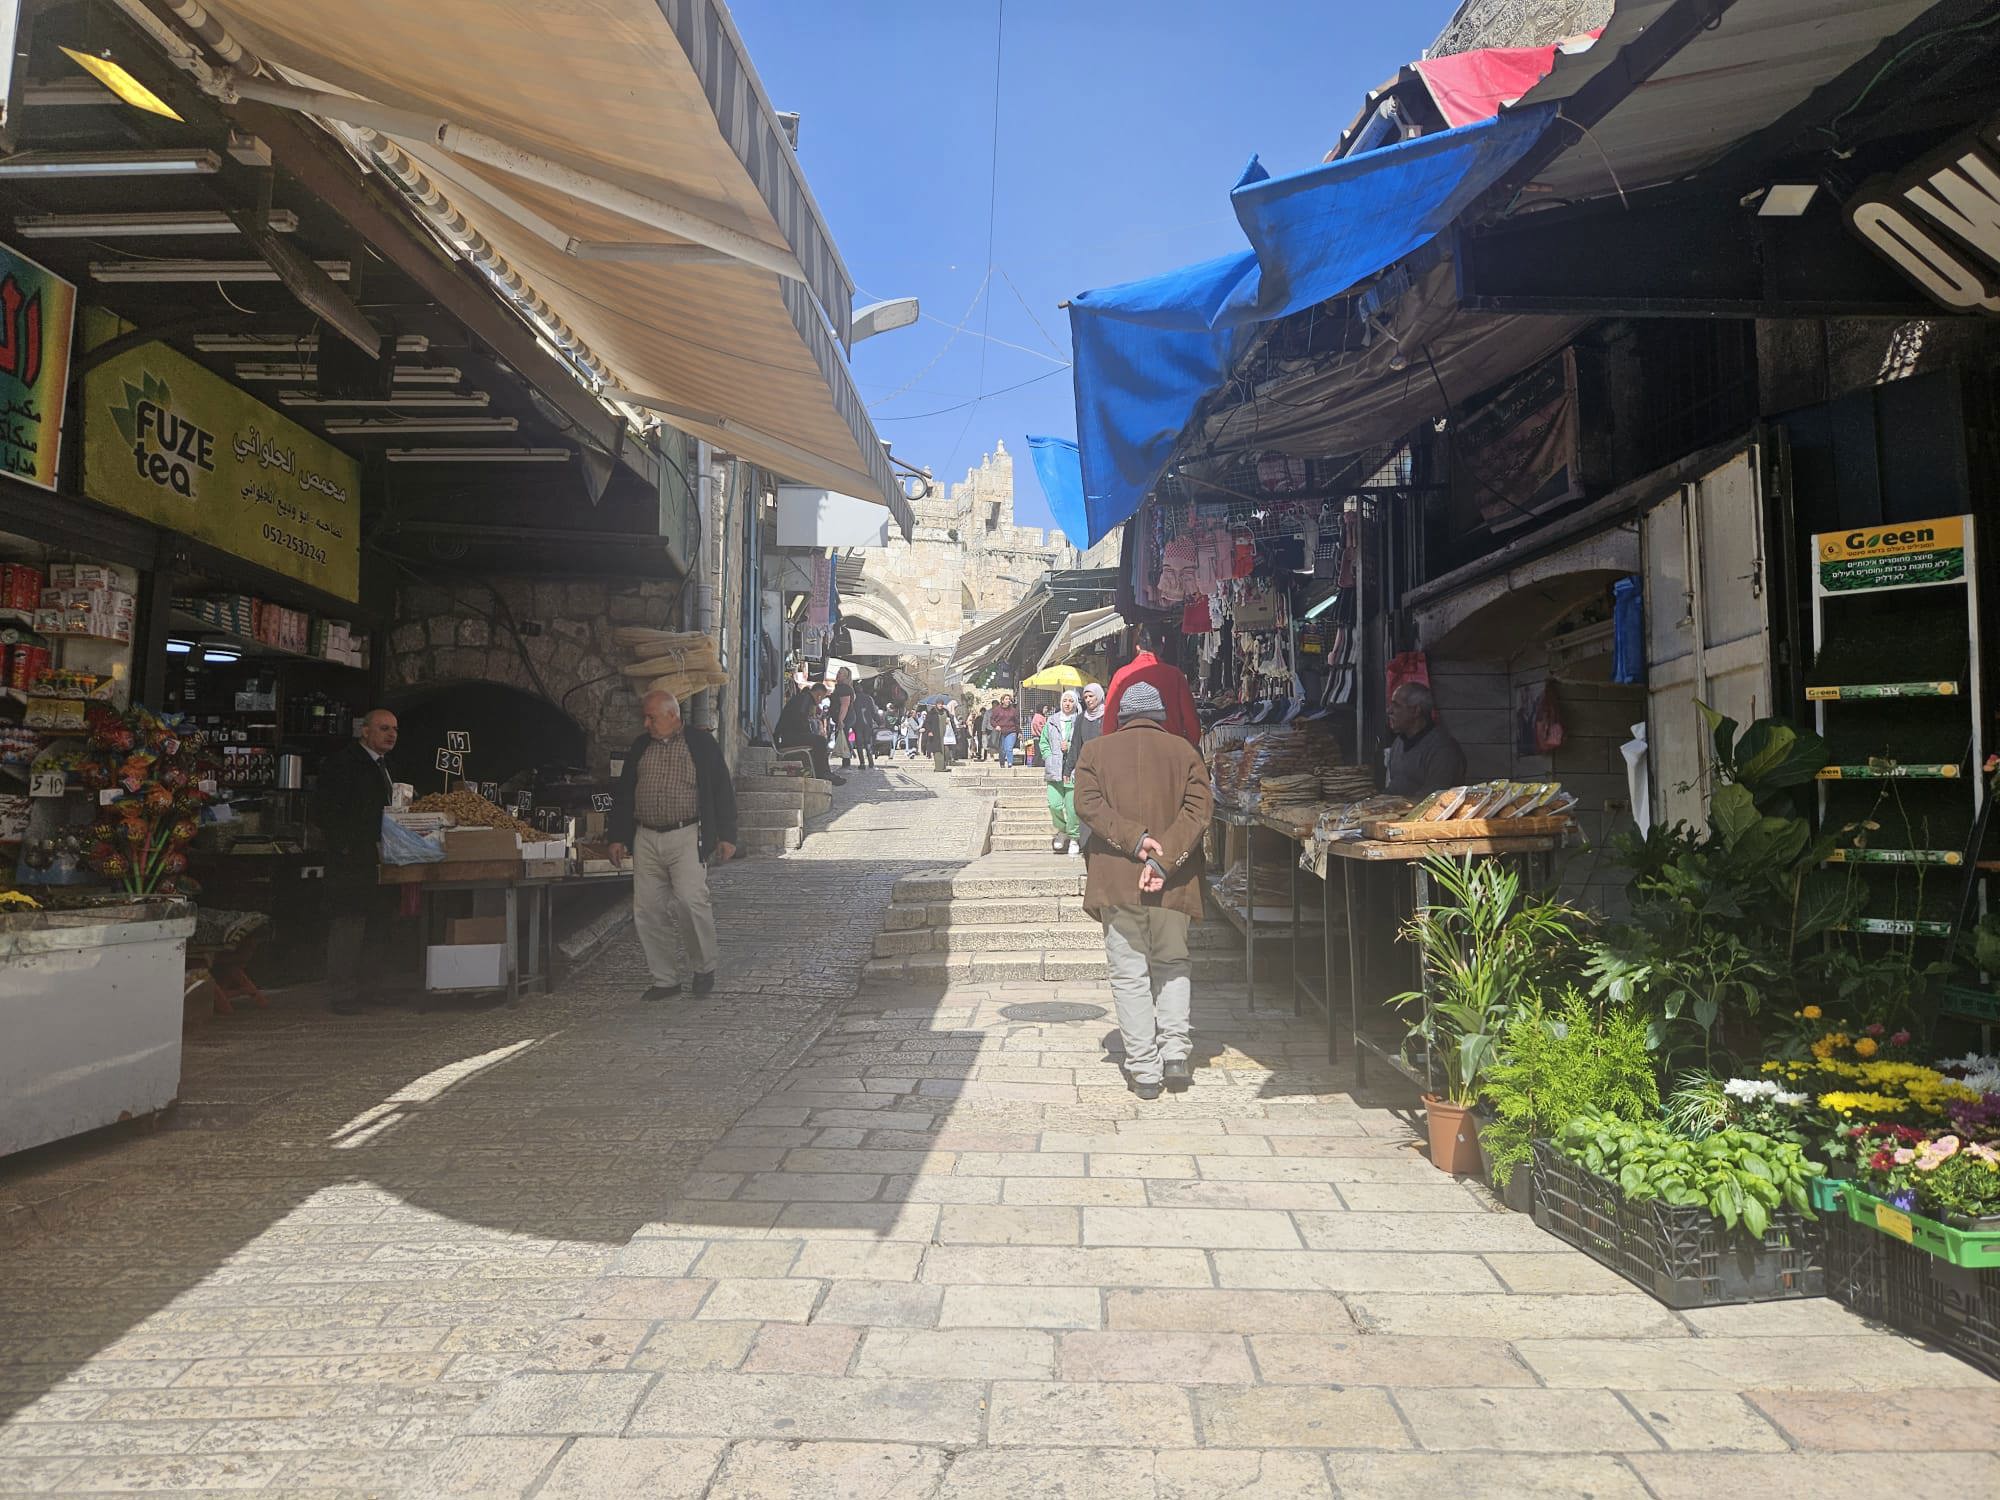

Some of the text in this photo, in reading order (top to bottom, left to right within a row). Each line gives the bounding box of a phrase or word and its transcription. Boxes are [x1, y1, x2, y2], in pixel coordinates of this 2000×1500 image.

[137, 401, 214, 472] FUZE
[133, 442, 191, 497] tea
[232, 426, 346, 504] محمص الحلواني
[263, 523, 327, 565] 052-2532242
[1879, 556, 1911, 565] מחומרים
[1912, 553, 1933, 562] מיוצר
[1934, 560, 1949, 569] ללא
[1909, 562, 1933, 571] מתכות
[1893, 573, 1904, 581] לא
[451, 734, 464, 749] 15
[440, 752, 460, 768] 30
